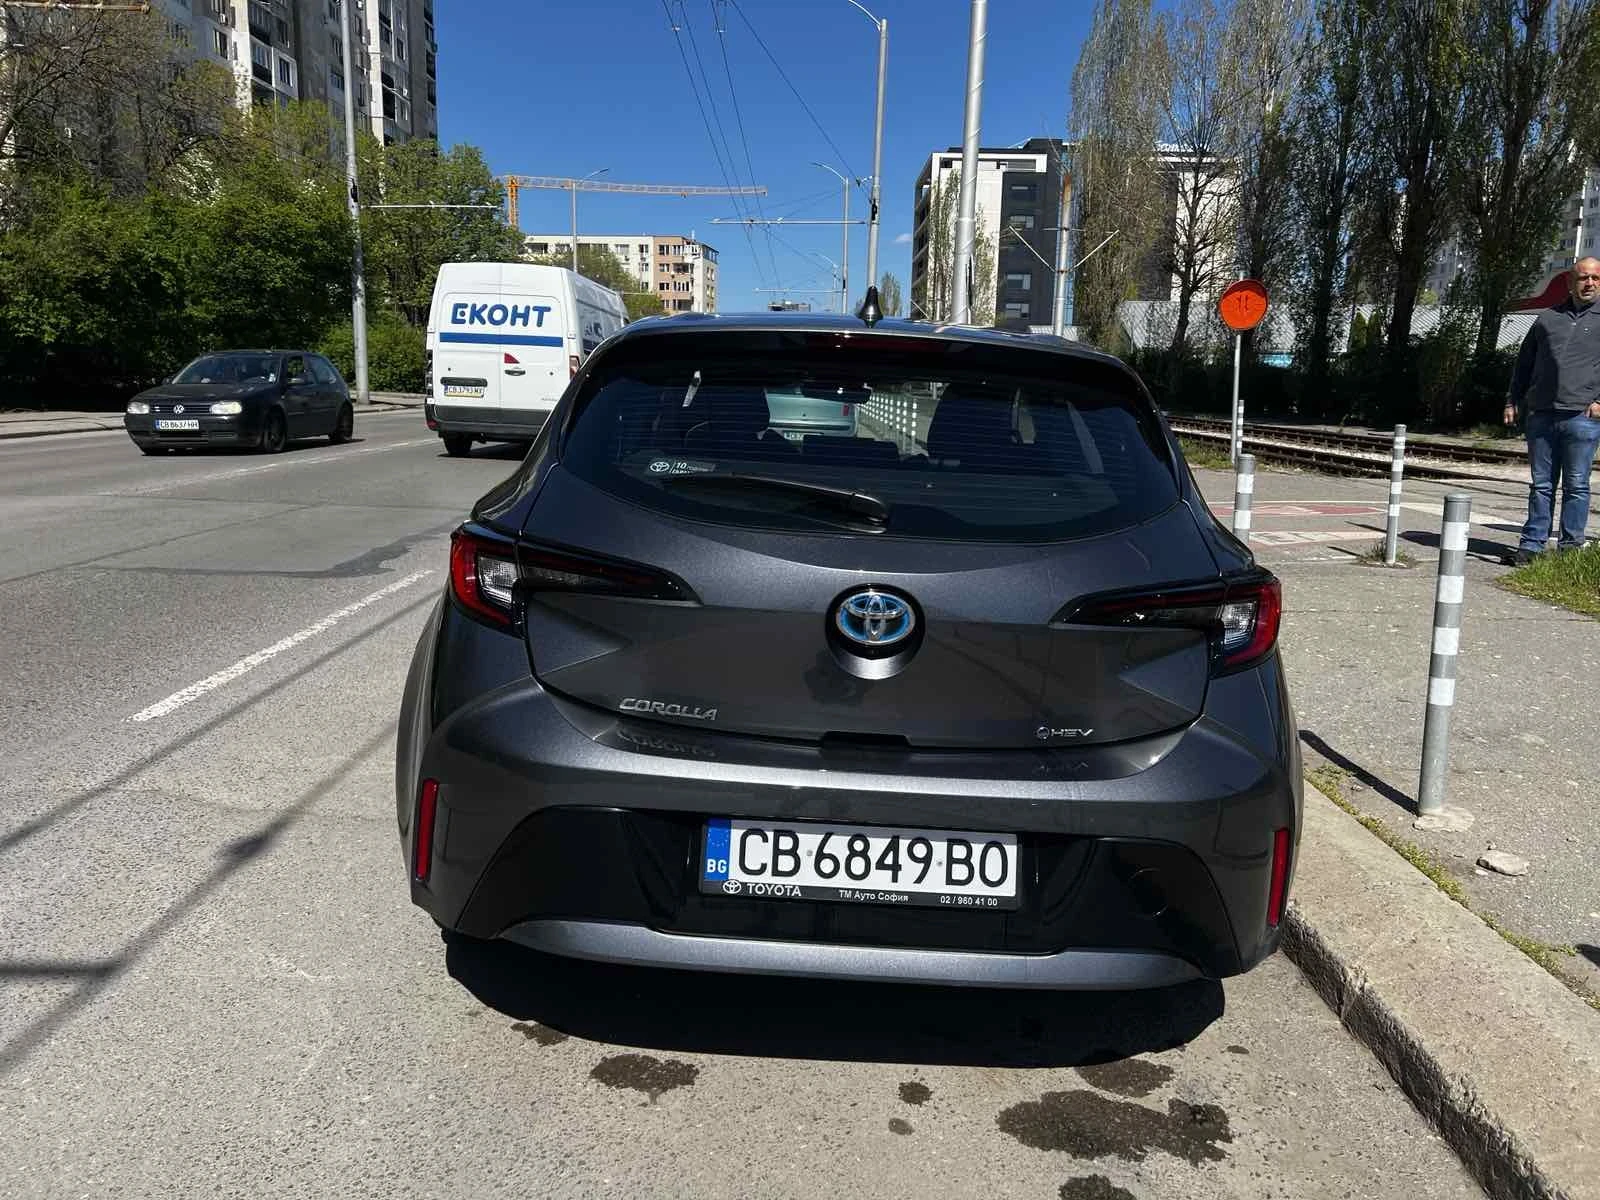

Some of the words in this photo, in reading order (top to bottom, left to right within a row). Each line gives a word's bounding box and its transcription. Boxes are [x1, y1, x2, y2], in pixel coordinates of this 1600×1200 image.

[451, 302, 552, 327] ЕКОНТ
[619, 698, 718, 720] COROLLA
[1050, 728, 1094, 737] HEV
[738, 828, 801, 878] CB
[813, 831, 934, 885] 6849
[706, 858, 727, 873] BG
[746, 882, 802, 898] TOYOTA
[854, 890, 876, 901] Ауто
[877, 892, 909, 902] София
[940, 895, 951, 904] 02
[987, 897, 998, 906] 00
